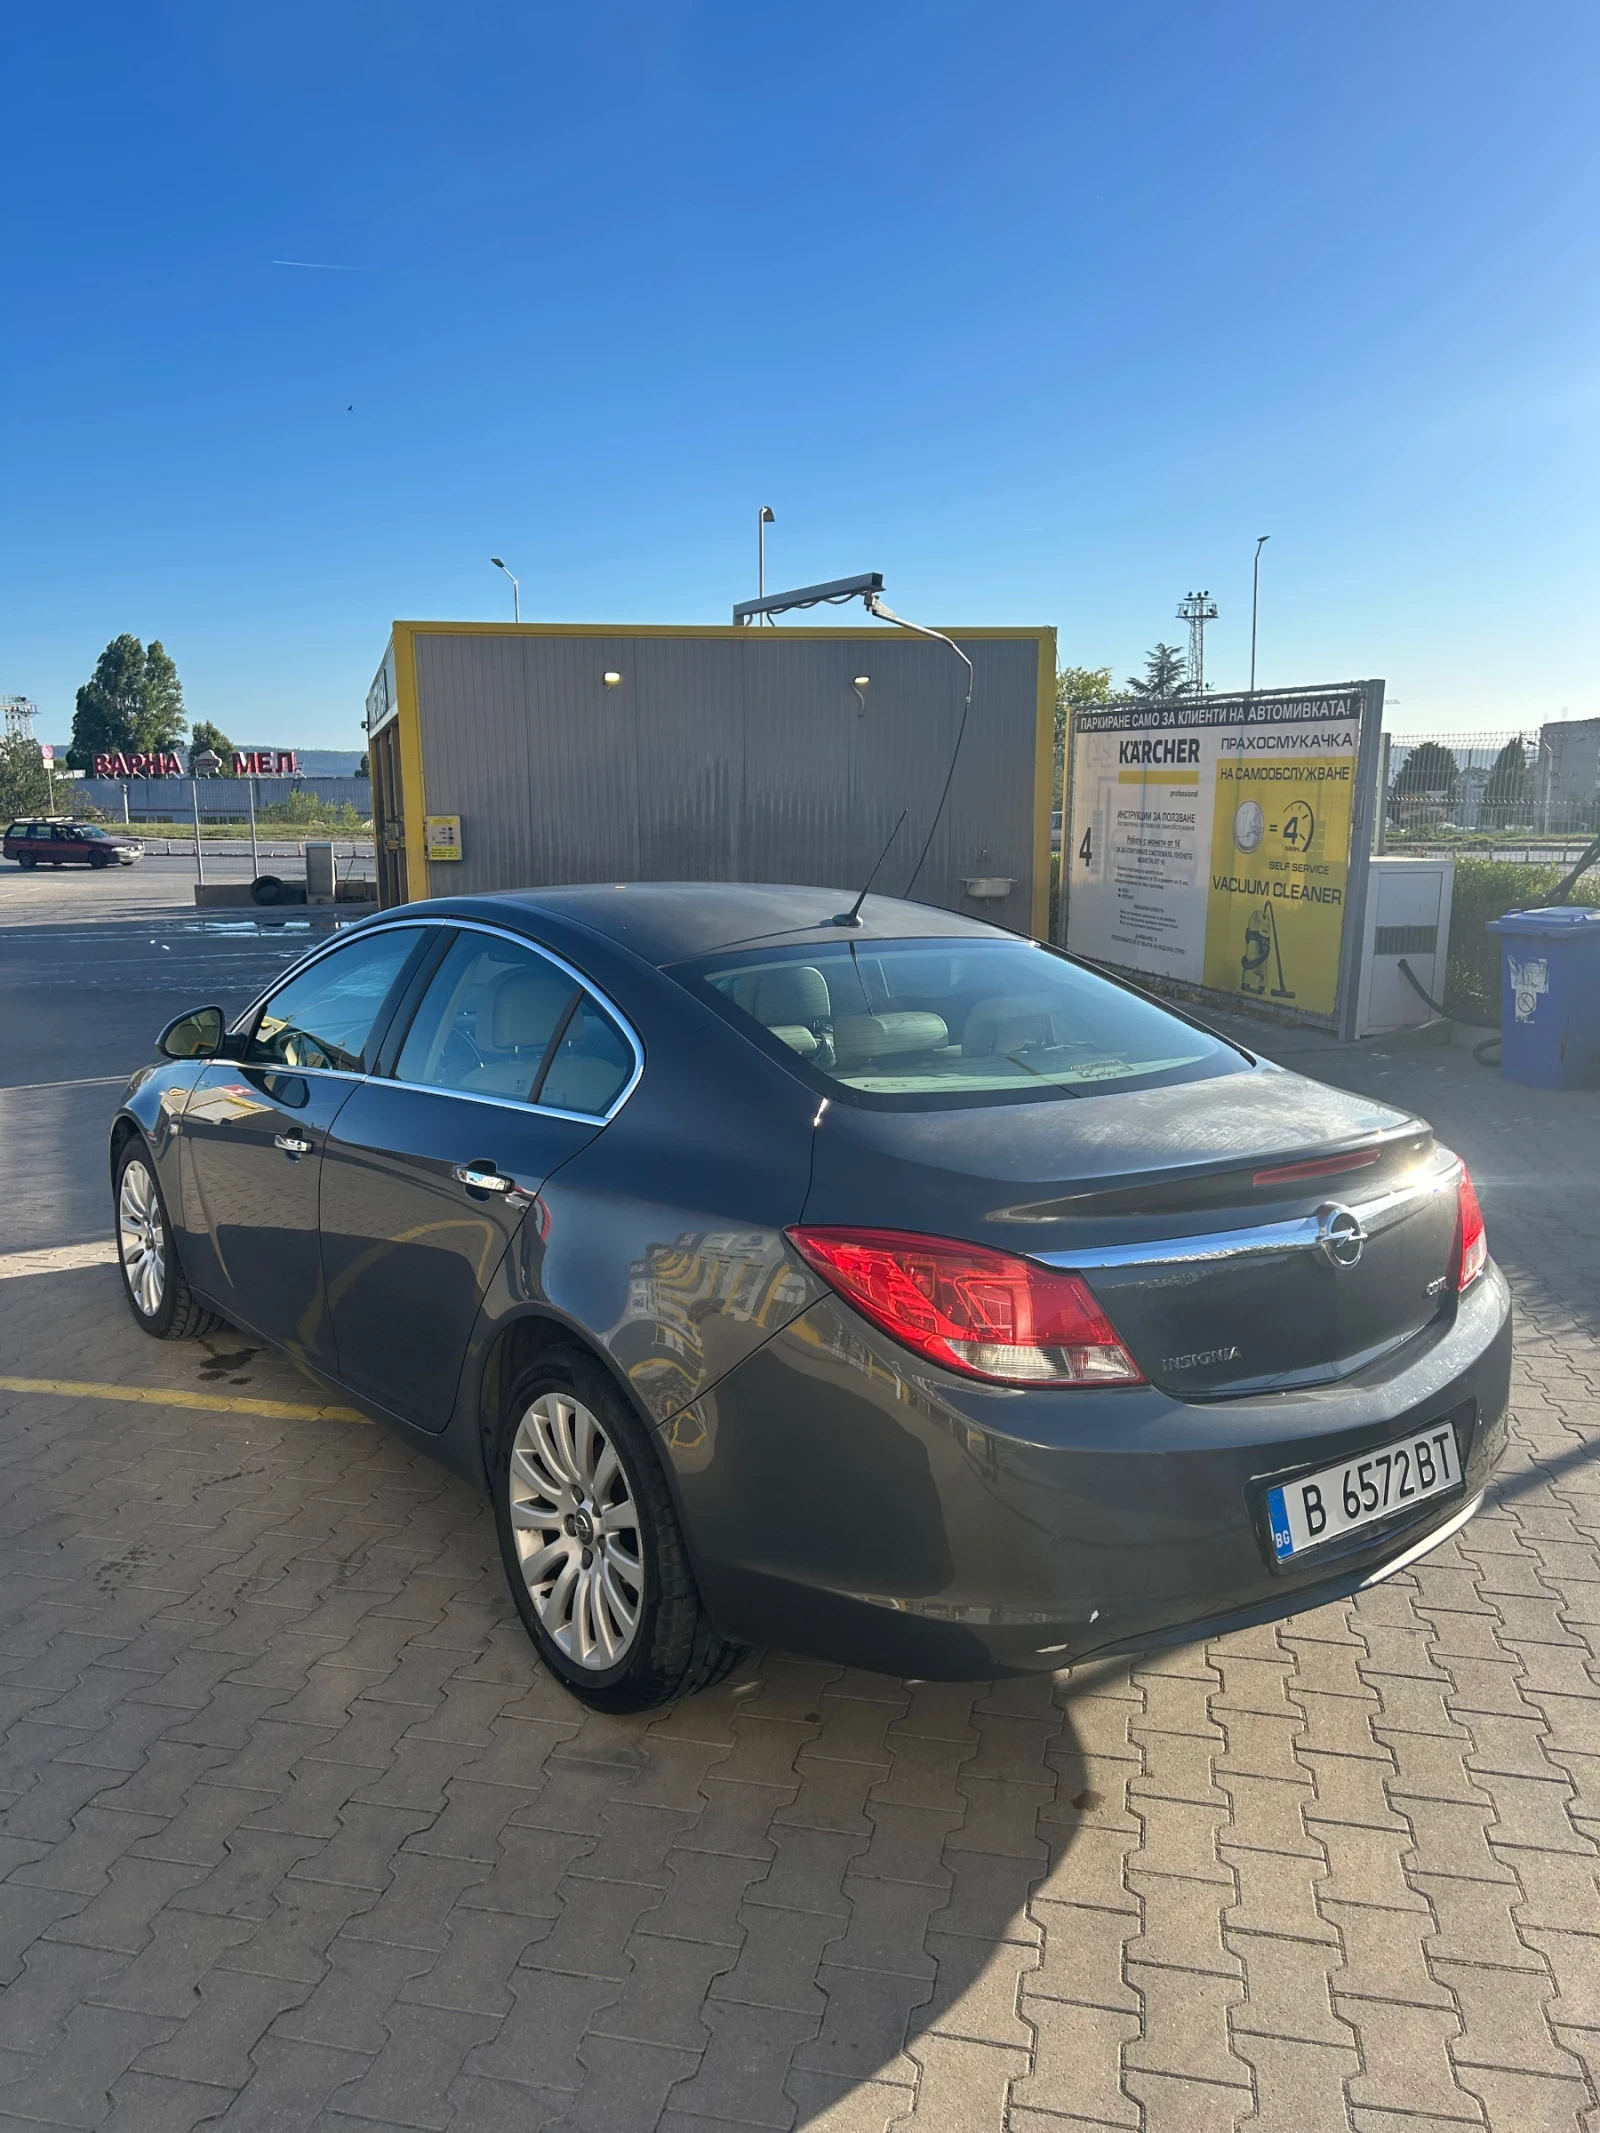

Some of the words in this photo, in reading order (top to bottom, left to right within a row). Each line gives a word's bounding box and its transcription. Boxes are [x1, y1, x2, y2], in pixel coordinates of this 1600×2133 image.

[1080, 714, 1130, 730] ПАРКИРАНЕ
[1132, 712, 1160, 727] САМО
[1162, 711, 1175, 726] ЗА
[1178, 708, 1227, 725] КЛИЕНТИ
[1229, 706, 1245, 722] НА
[1248, 698, 1351, 721] АВТОМИВКАТА!
[1119, 738, 1200, 764] KÄRCHER
[1221, 732, 1353, 750] ПРАХОСМУКАЧКА
[92, 752, 185, 775] ВАРНА
[231, 751, 297, 774] МЕЛ
[1221, 767, 1234, 780] НА
[1235, 766, 1350, 781] САМООБСЛУЖВАНЕ
[1170, 790, 1198, 798] professional
[1117, 810, 1152, 821] ИНСТРУКЦИИ
[1153, 811, 1161, 821] ЗА
[1162, 812, 1196, 823] ПОЛЗВАНЕ
[1283, 816, 1298, 845] 4
[1079, 827, 1093, 867] 4
[1269, 861, 1290, 871] SELF
[1291, 863, 1330, 875] SERVICE
[1212, 875, 1269, 896] VACUUM
[1273, 882, 1342, 905] CLEANER
[1161, 1346, 1243, 1373] INSIGNIA
[1301, 1483, 1327, 1537] B
[1275, 1529, 1291, 1549] BG
